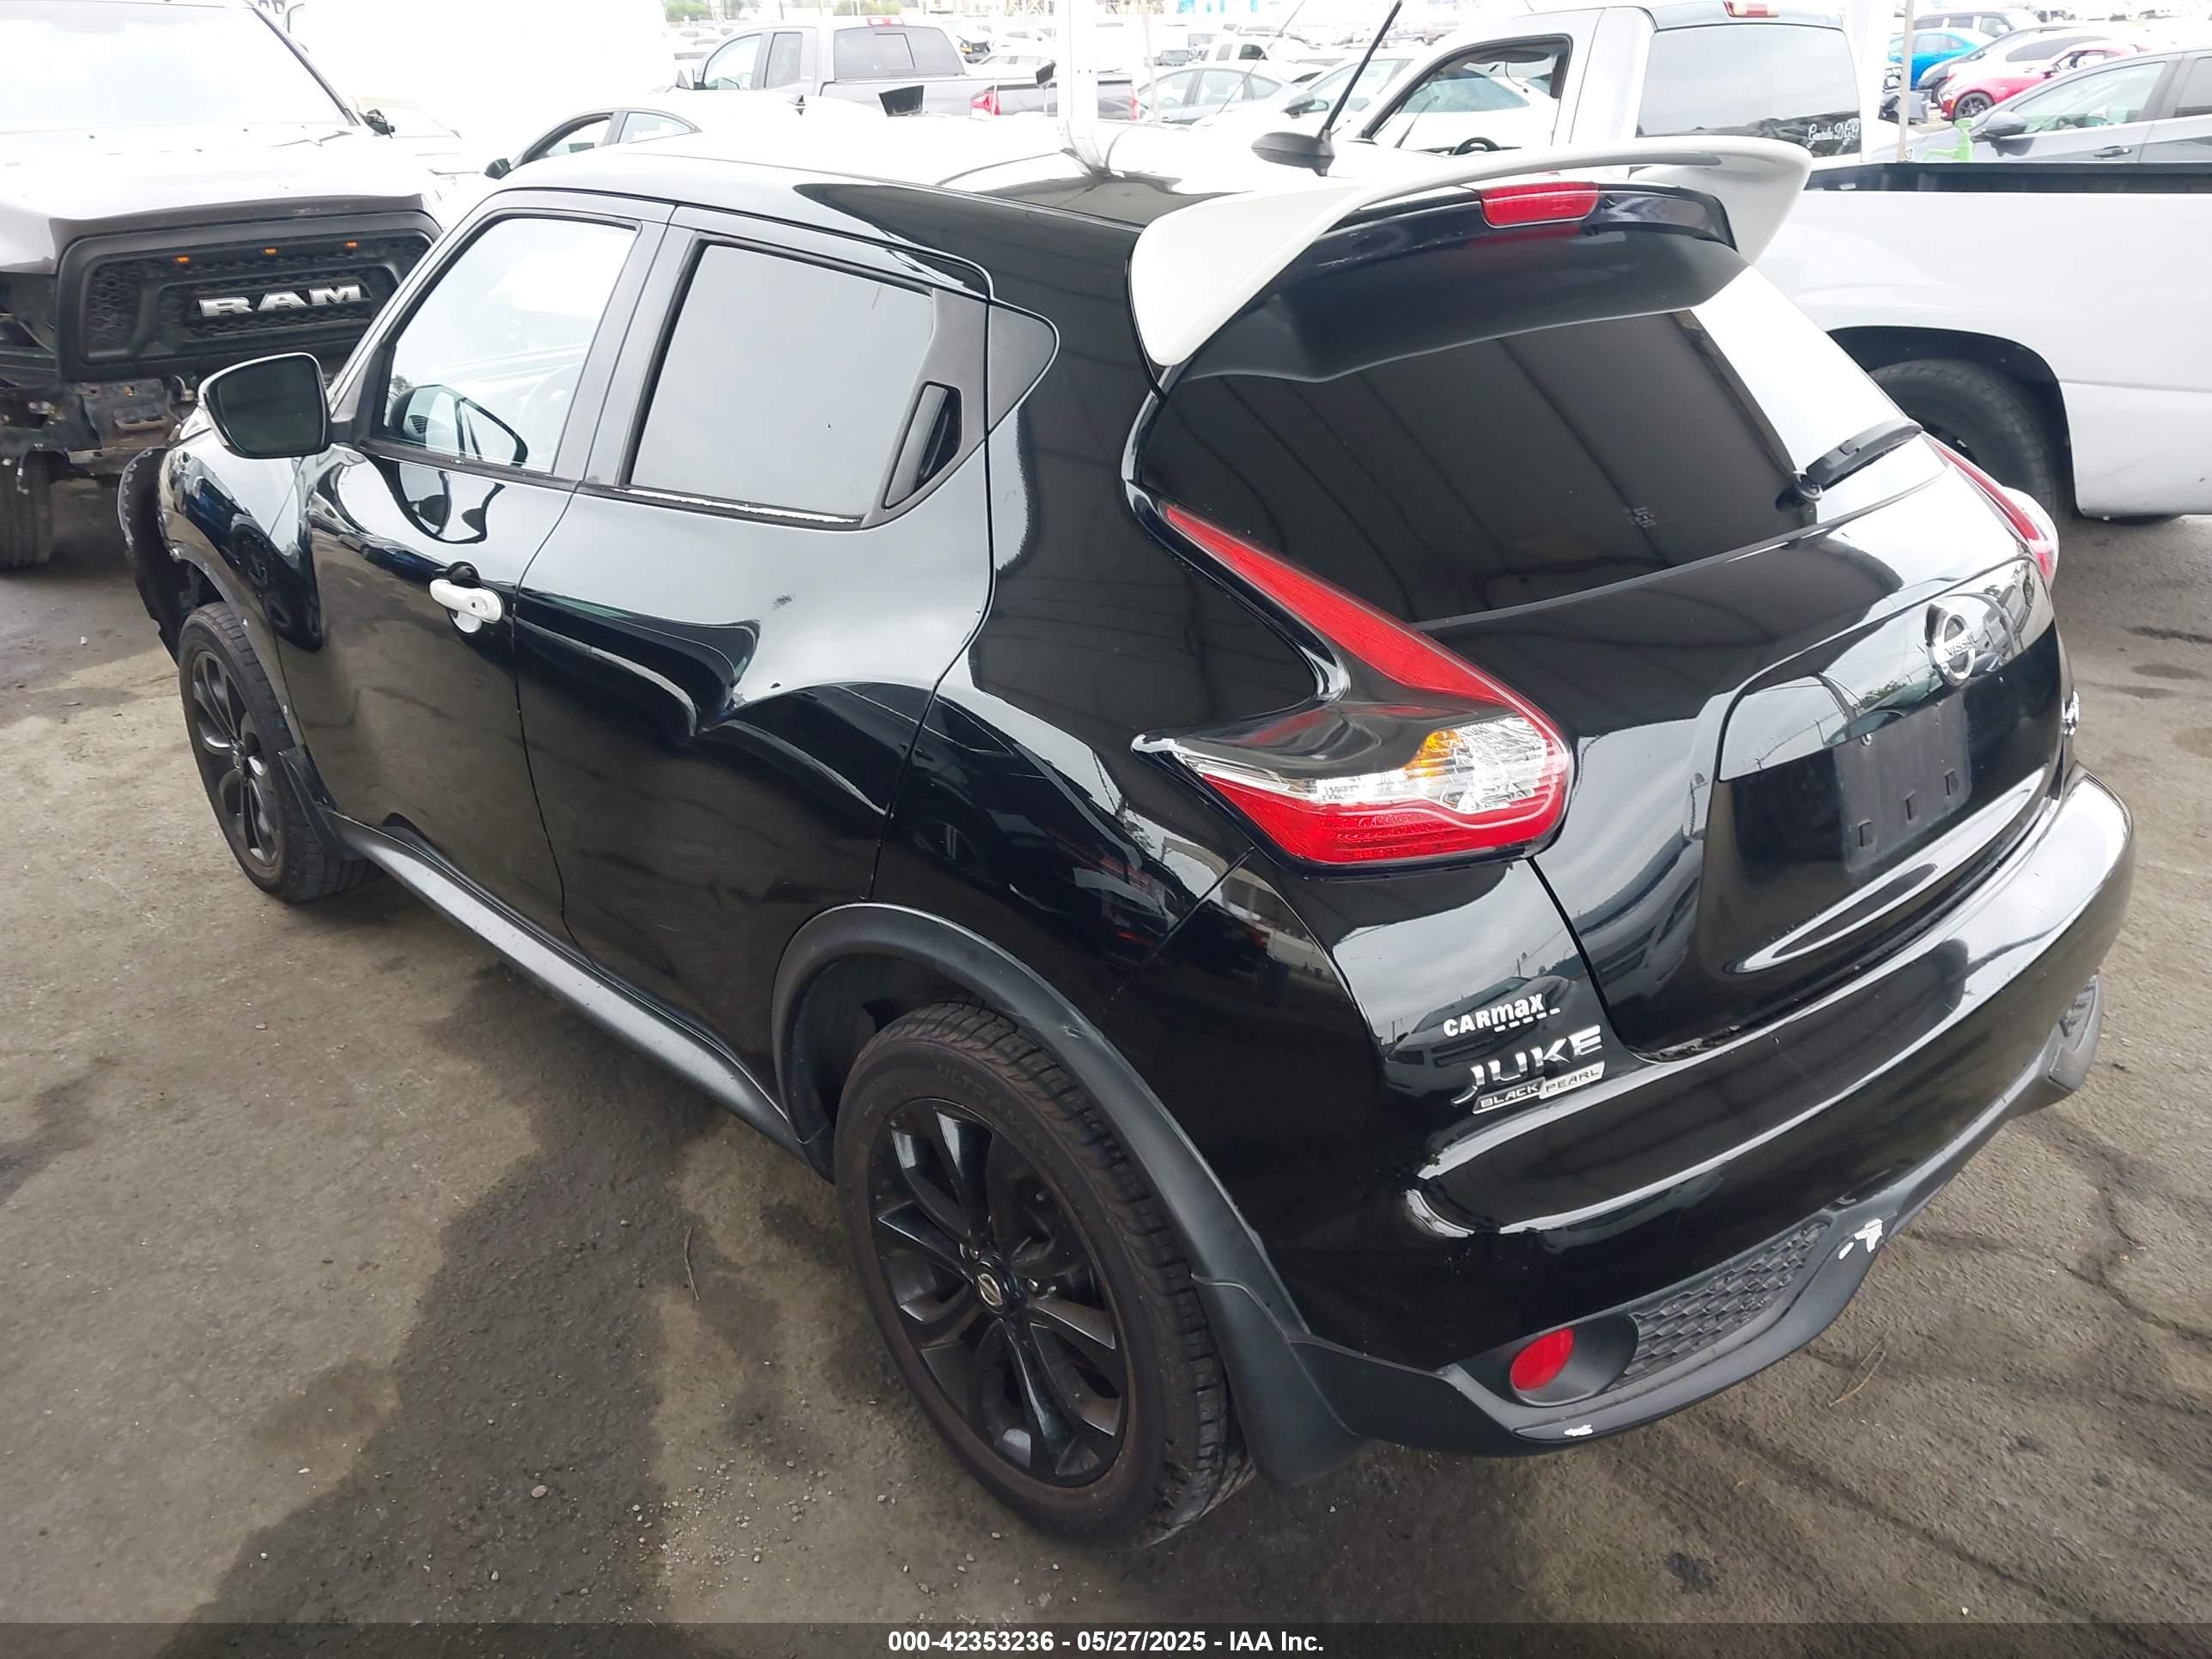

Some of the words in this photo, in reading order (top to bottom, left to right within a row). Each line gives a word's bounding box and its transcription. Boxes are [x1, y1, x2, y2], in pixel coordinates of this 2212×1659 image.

[198, 284, 362, 317] RAM
[1450, 1024, 1603, 1105] JUKE
[1480, 1084, 1540, 1109] BLACK
[1546, 1068, 1601, 1093] PEARL
